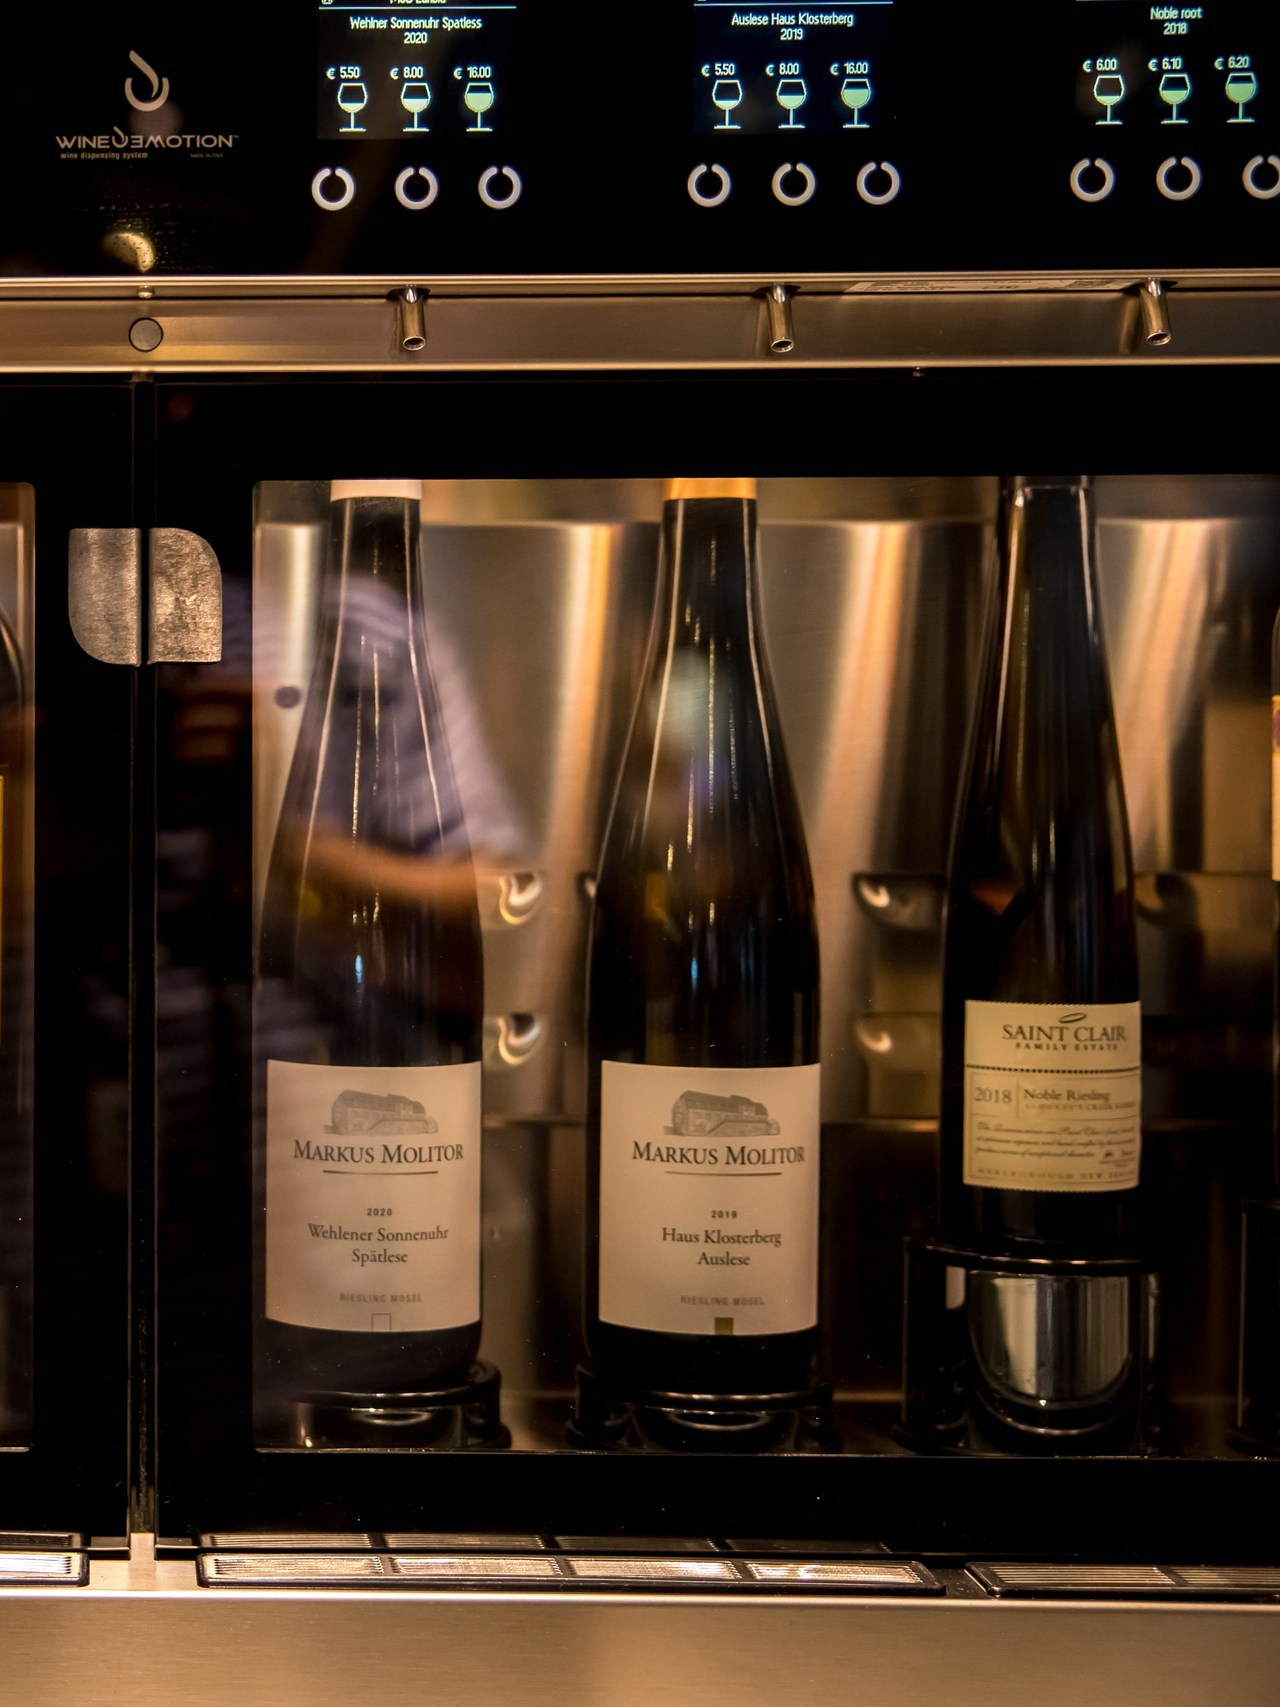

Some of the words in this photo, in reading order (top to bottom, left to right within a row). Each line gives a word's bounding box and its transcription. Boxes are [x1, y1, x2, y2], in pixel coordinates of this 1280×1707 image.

[731, 13, 769, 26] Auslese
[771, 13, 796, 26] Haus
[798, 12, 854, 27] Klosterberg
[1150, 7, 1178, 20] Noble
[1181, 7, 1203, 19] root
[349, 16, 388, 30] Wehlner
[390, 17, 440, 30] Sonnenuhr
[442, 17, 483, 31] Spatless
[1163, 23, 1188, 35] 2018
[403, 32, 428, 44] 2020
[780, 28, 804, 41] 2019
[843, 62, 868, 75] 16.00
[1096, 58, 1117, 72] 6.00
[1162, 58, 1182, 70] 6.10
[1228, 56, 1249, 69] 6.20
[340, 66, 360, 79] 5.50
[403, 66, 424, 79] 8.00
[467, 66, 491, 79] 16.00
[714, 63, 735, 76] 5.50
[779, 63, 800, 76] 8.00
[80, 152, 120, 160] dispensing
[122, 152, 148, 160] system
[1002, 1024, 1069, 1042] SAINT
[1073, 1026, 1127, 1042] CLAIR
[1015, 1042, 1067, 1051] FAMILY
[974, 1087, 1012, 1104] 2018
[1024, 1089, 1062, 1100] Noble
[293, 1139, 375, 1164] MARKUS
[381, 1143, 464, 1164] MOLITOR
[632, 1141, 718, 1165] MARKUS
[724, 1145, 806, 1165] MOLITOR
[366, 1207, 393, 1217] 2020
[711, 1210, 737, 1219] 2019
[308, 1223, 373, 1242] Wehlener
[376, 1225, 449, 1242] Sonnenuhr
[662, 1227, 700, 1243] Haus
[704, 1229, 783, 1248] Klosterberg
[352, 1248, 408, 1267] Spätlese
[696, 1251, 751, 1266] Auslese
[339, 1292, 387, 1303] RIESLING
